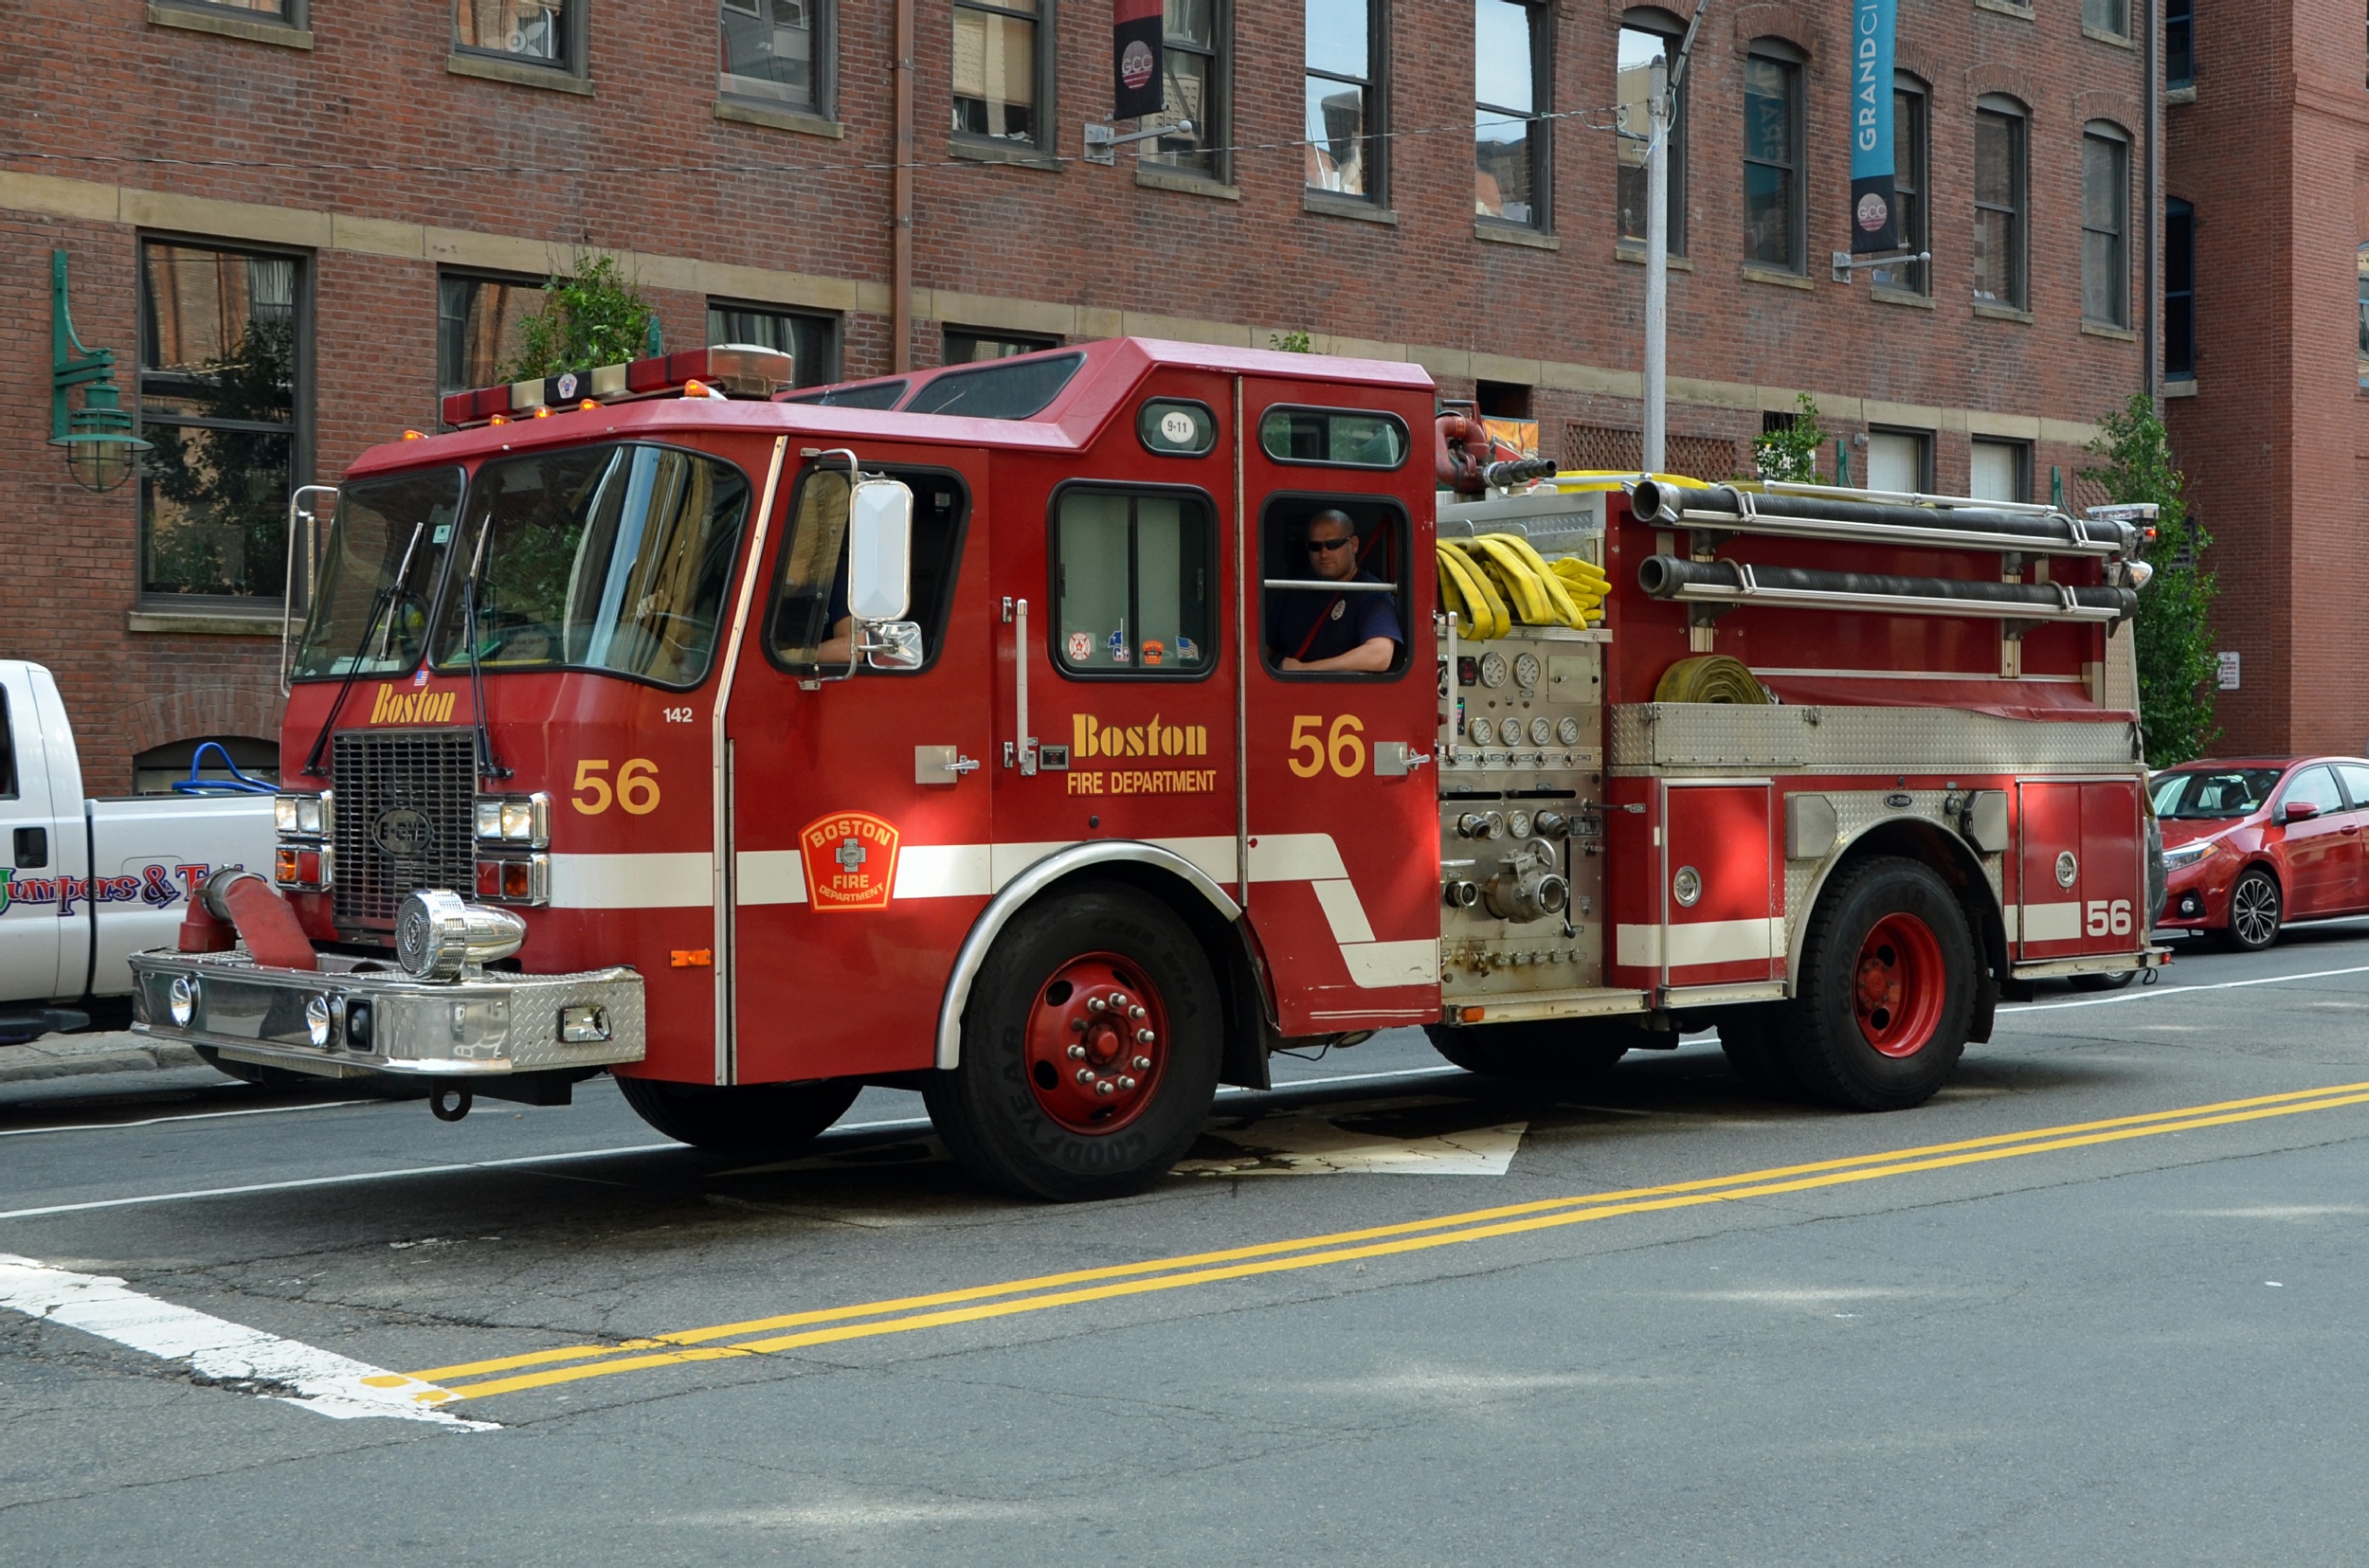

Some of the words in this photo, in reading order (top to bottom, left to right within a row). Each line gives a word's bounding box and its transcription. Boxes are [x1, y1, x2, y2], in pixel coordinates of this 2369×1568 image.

[1122, 54, 1153, 75] GCC
[1859, 0, 1878, 152] GRANDCI
[1857, 205, 1887, 219] GCC
[1167, 420, 1186, 433] 9-11
[370, 683, 456, 724] Boston
[663, 708, 694, 723] 142
[1073, 713, 1207, 757] Boston
[1288, 713, 1365, 778] 56
[571, 759, 660, 815] 56
[1068, 772, 1104, 795] FIRE
[1112, 770, 1217, 794] DEPARTMENT
[810, 820, 891, 848] BOSTON
[142, 864, 181, 909] &
[819, 882, 884, 902] DEPARTMENT
[833, 874, 869, 889] FIRE
[2087, 899, 2131, 937] 56
[1001, 1024, 1148, 1170] GOODYEAR
